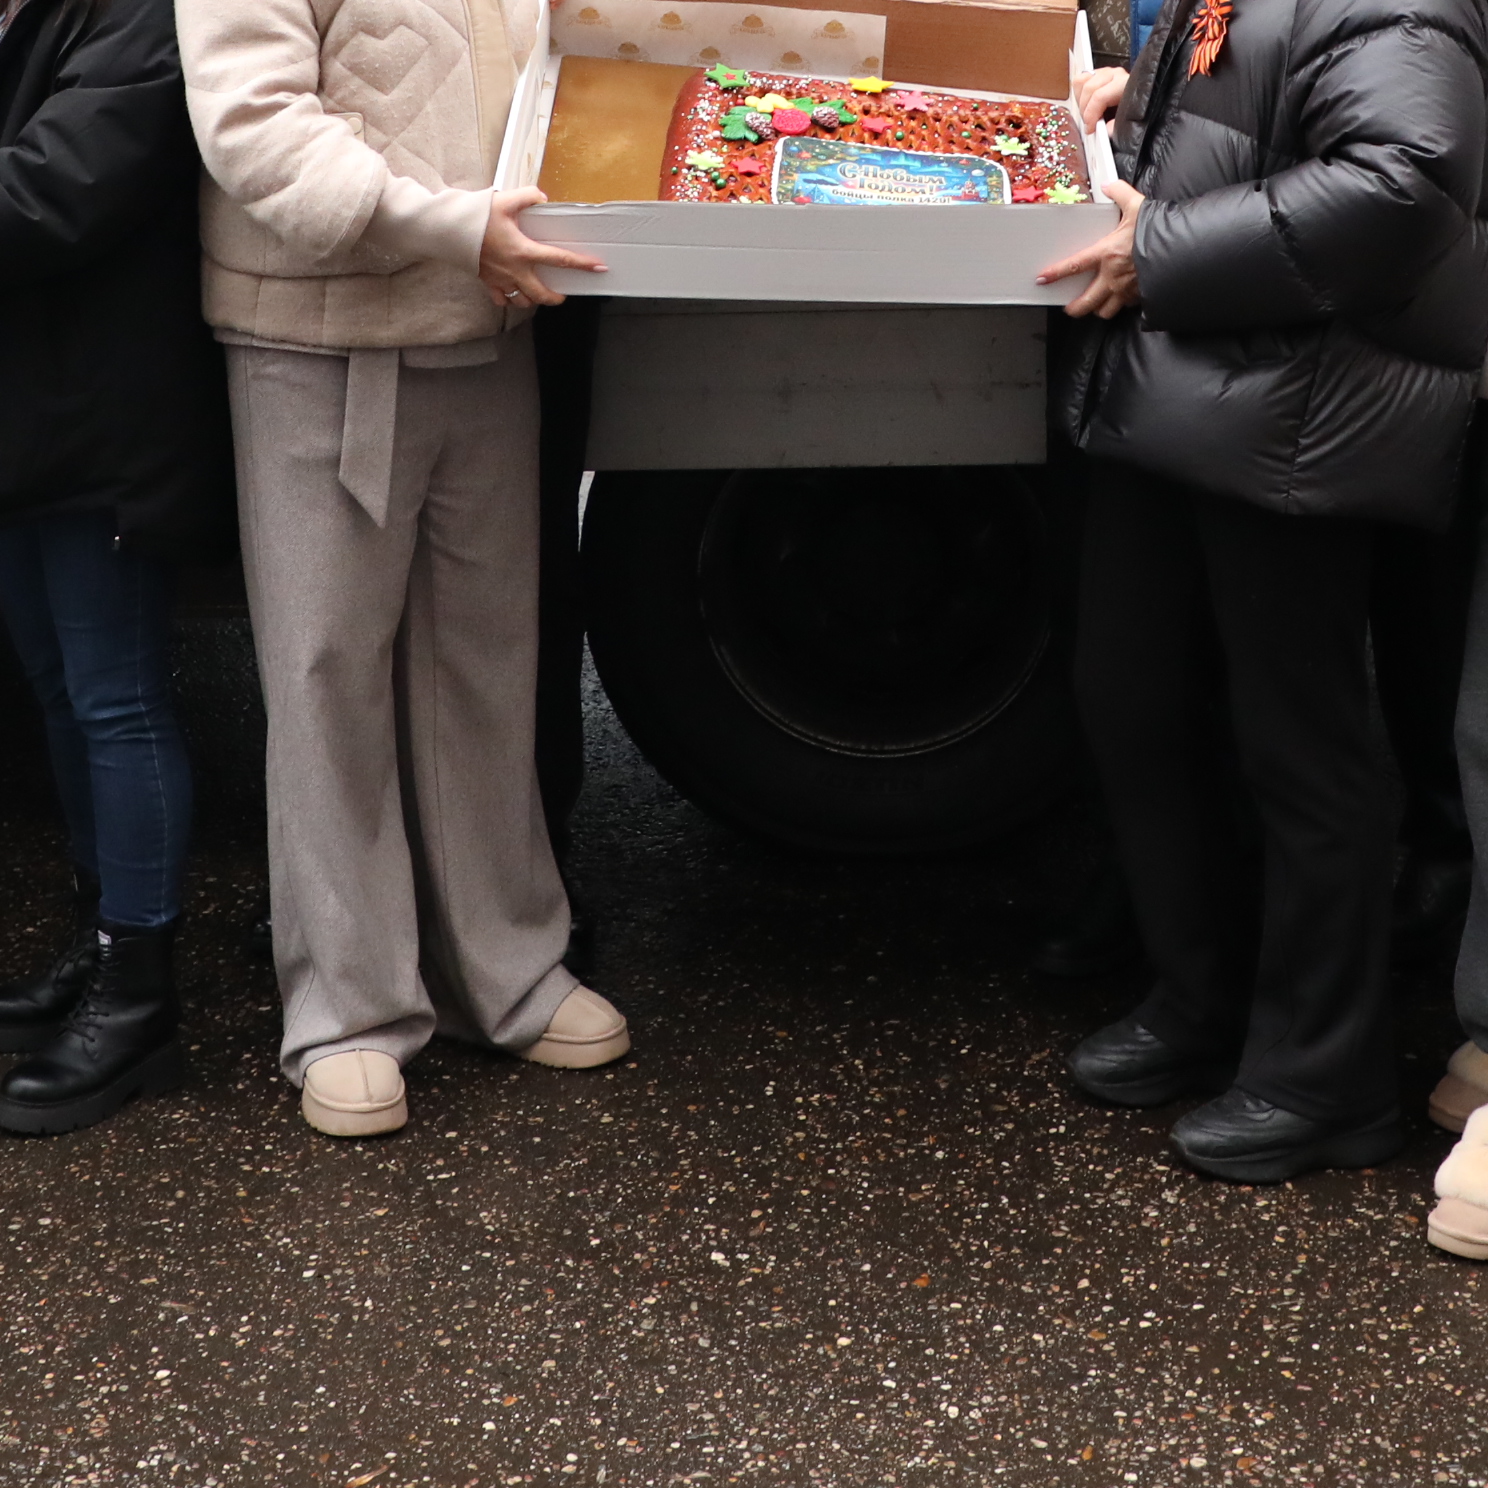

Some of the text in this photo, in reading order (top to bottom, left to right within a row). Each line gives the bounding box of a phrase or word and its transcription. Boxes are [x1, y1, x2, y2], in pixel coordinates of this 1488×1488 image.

[837, 162, 947, 186] С Новым
[831, 188, 874, 200] бойцы
[876, 193, 915, 203] полка
[857, 175, 935, 196] Годом!
